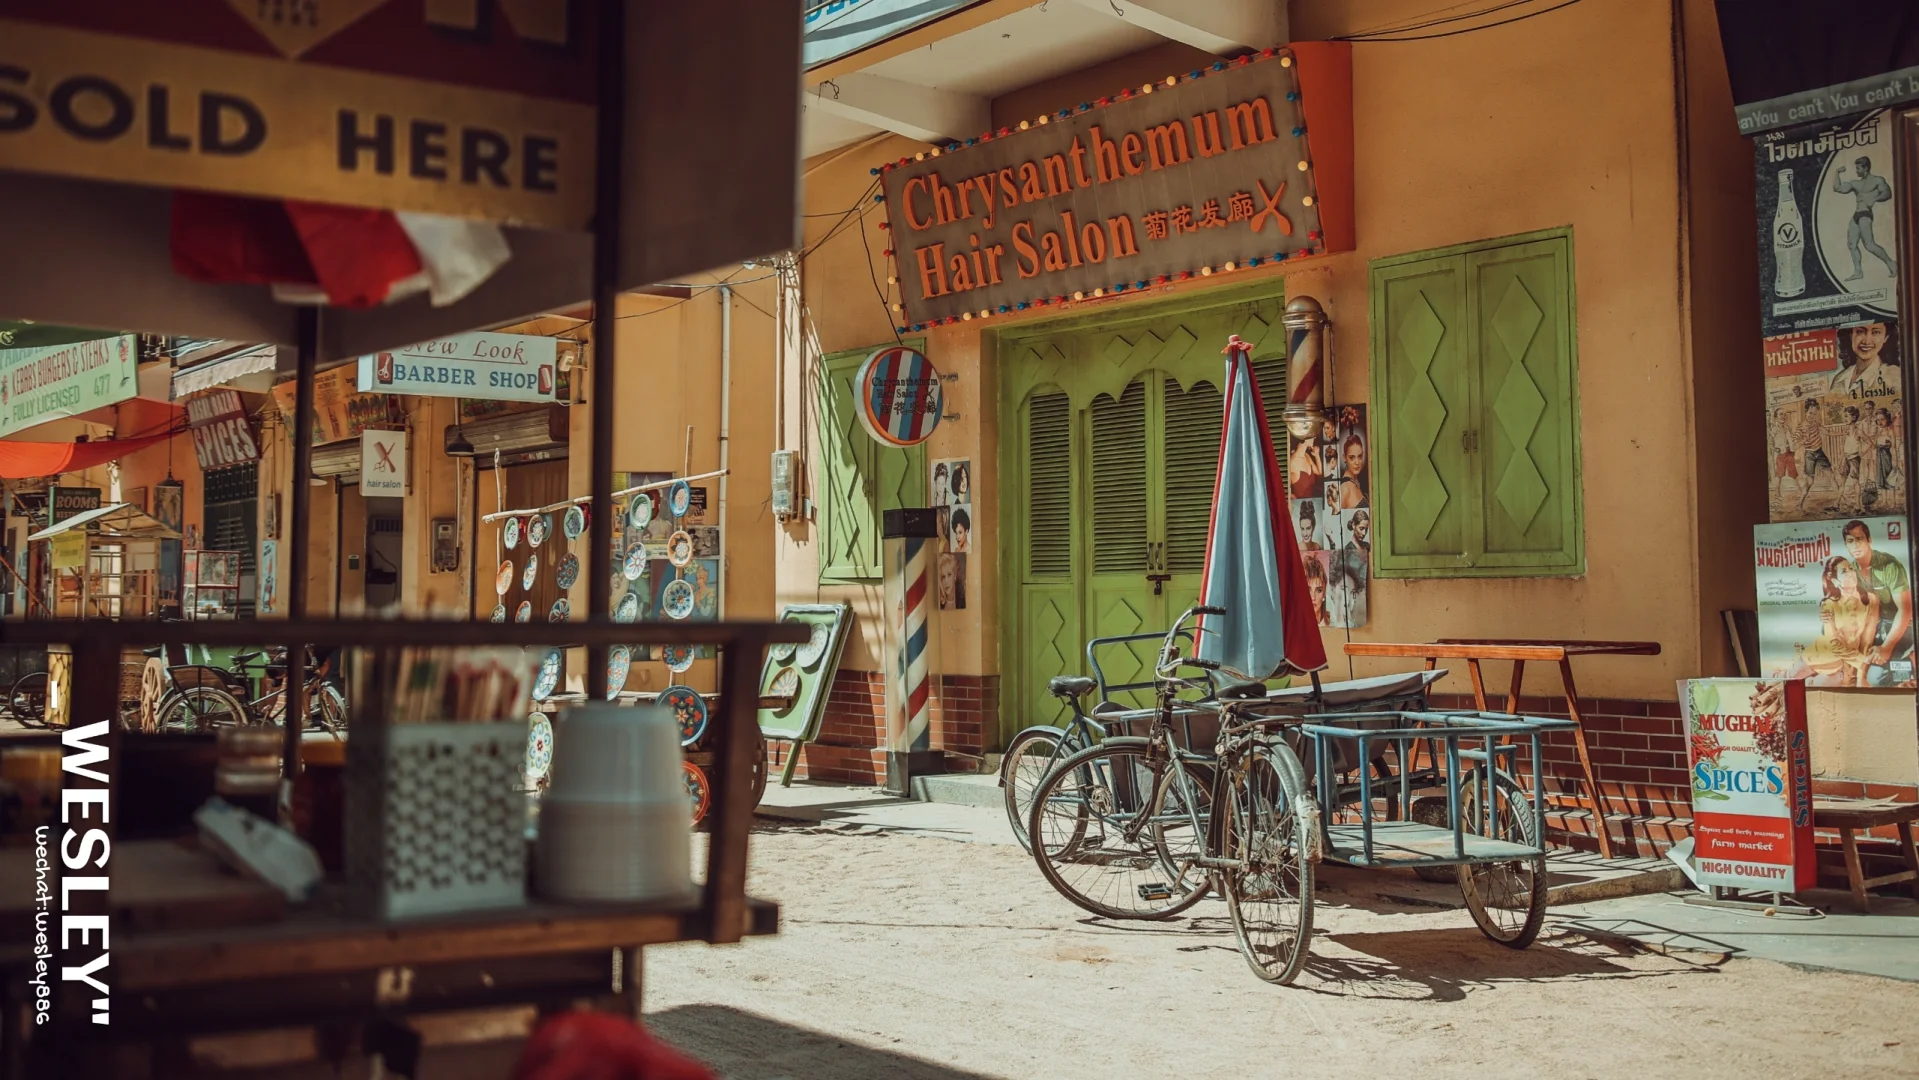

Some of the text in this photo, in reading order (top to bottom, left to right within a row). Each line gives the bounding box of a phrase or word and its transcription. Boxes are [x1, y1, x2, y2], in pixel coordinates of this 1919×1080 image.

[1788, 98, 1824, 120] can't
[1829, 92, 1860, 114] You
[1864, 78, 1904, 104] can't
[0, 63, 560, 193] SOLD HERE
[902, 96, 1278, 231] Chrysanthemum
[1141, 190, 1255, 241] 菊花发廊
[914, 210, 1139, 301] Hair Salon
[1776, 238, 1802, 248] VITAMILK
[473, 339, 529, 364] Look
[12, 362, 37, 397] KEBABS
[38, 348, 72, 388] BURGERS
[73, 346, 78, 376] &
[80, 338, 110, 373] STEAKS
[393, 363, 537, 389] BARBER SHOP
[871, 376, 939, 388] Chrysanthemum
[896, 388, 918, 399] Salon
[12, 373, 111, 423] FULLY LICENSED 477
[193, 417, 257, 468] SPICES
[366, 479, 401, 488] hair salon
[56, 495, 98, 508] ROOMS
[1699, 713, 1777, 733] MUGHAL
[1731, 745, 1756, 753] QUALITY
[1790, 730, 1810, 828] SPICES
[1711, 837, 1774, 852] farm market
[1753, 830, 1785, 840] seasonings
[1701, 861, 1787, 880] HIGH QUALITY
